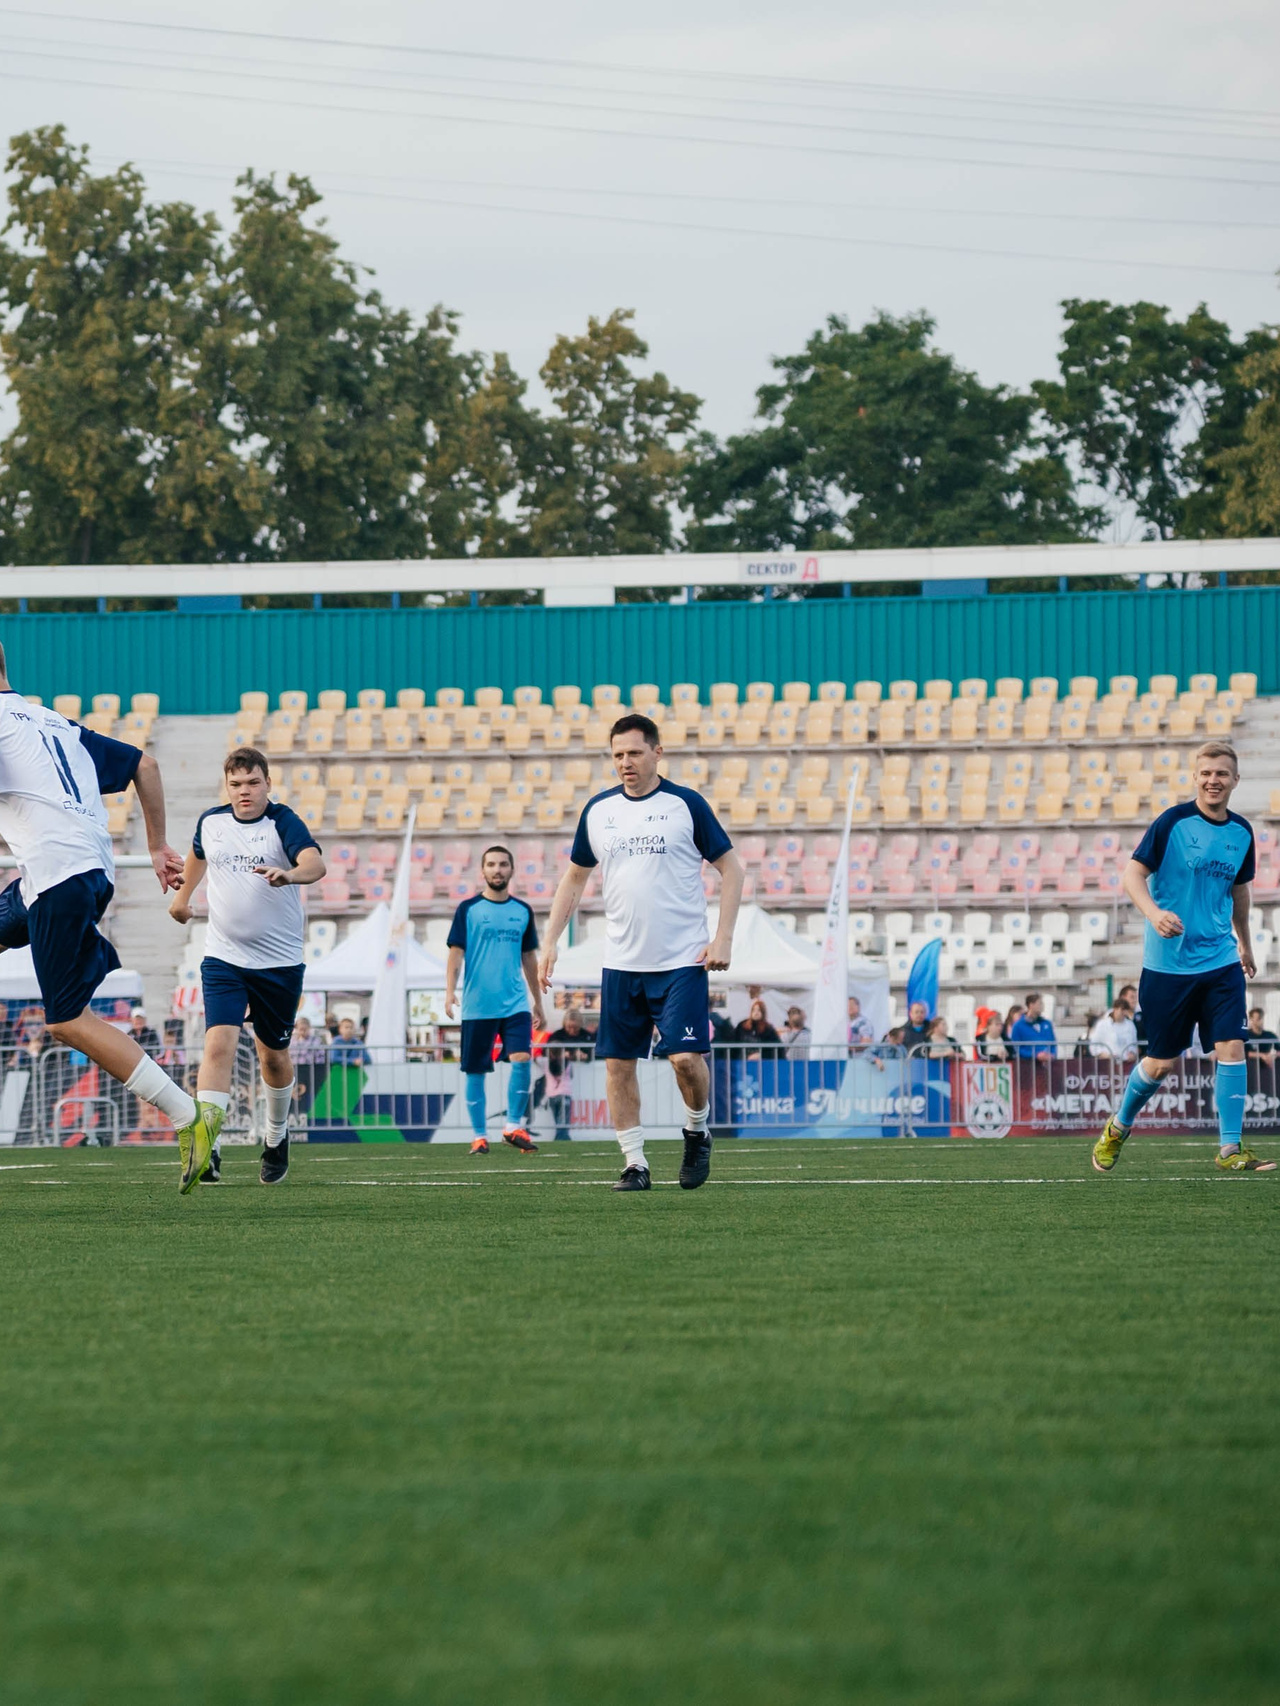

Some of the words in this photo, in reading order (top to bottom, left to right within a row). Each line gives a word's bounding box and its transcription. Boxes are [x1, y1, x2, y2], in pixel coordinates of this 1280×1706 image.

[747, 563, 797, 576] СЕКТОР
[801, 557, 819, 581] Д
[966, 1067, 1010, 1105] KIDS
